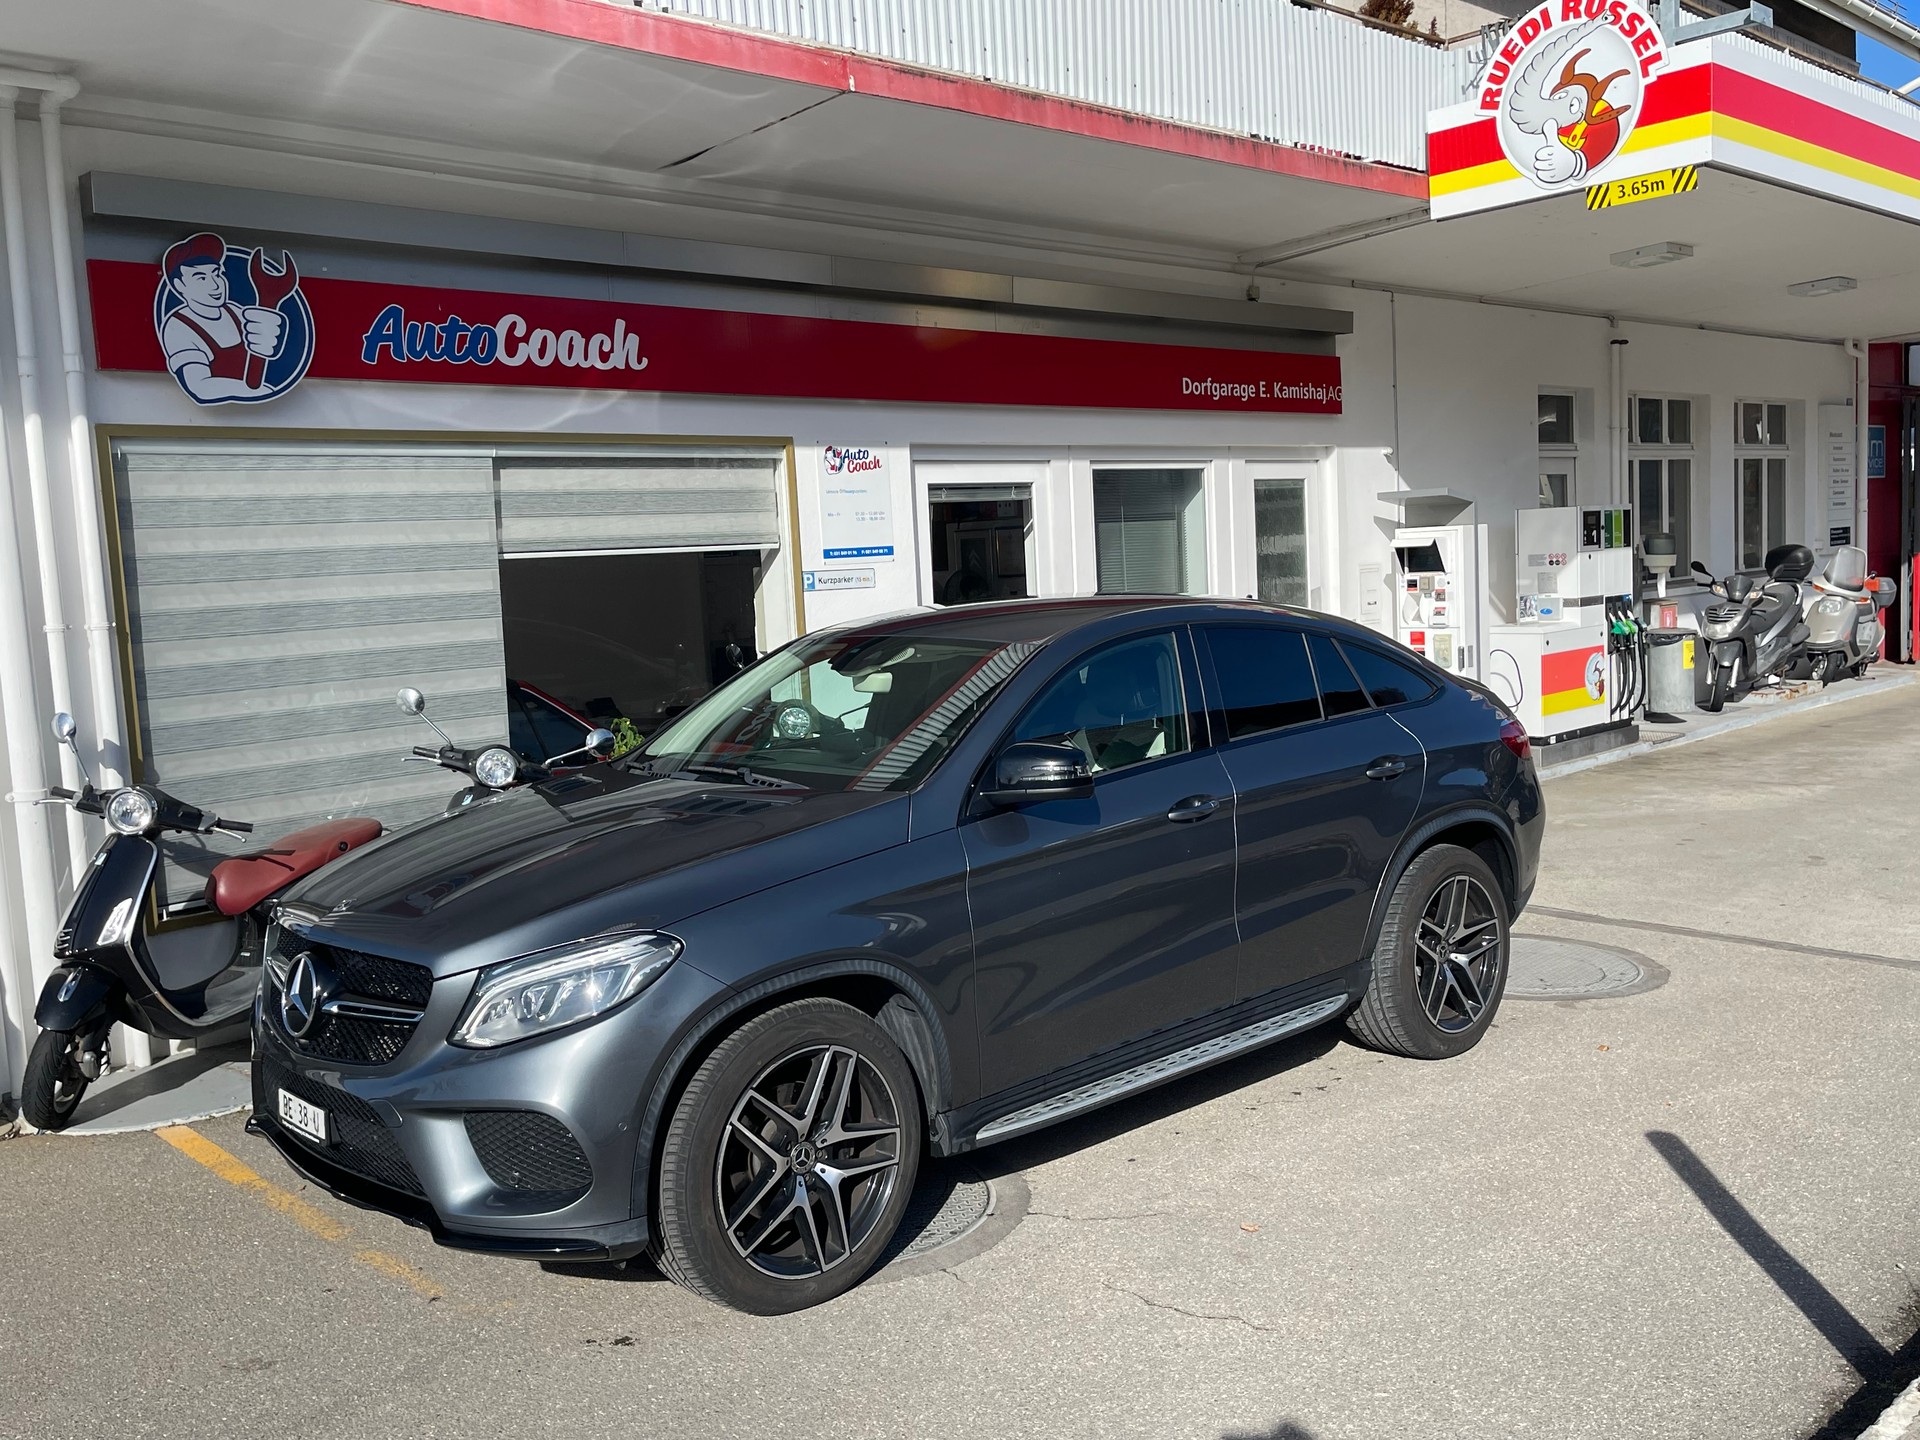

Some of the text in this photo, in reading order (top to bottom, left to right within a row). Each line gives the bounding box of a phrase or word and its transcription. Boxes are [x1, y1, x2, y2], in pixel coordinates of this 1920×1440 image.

[1480, 7, 1553, 110] RUEDI
[1617, 179, 1665, 199] 3.65m
[1182, 377, 1256, 401] Dorfgarage
[1259, 381, 1270, 398] E.
[843, 449, 869, 463] Auto
[847, 456, 882, 473] Coach
[804, 574, 814, 588] P
[818, 576, 854, 586] Kurzparker
